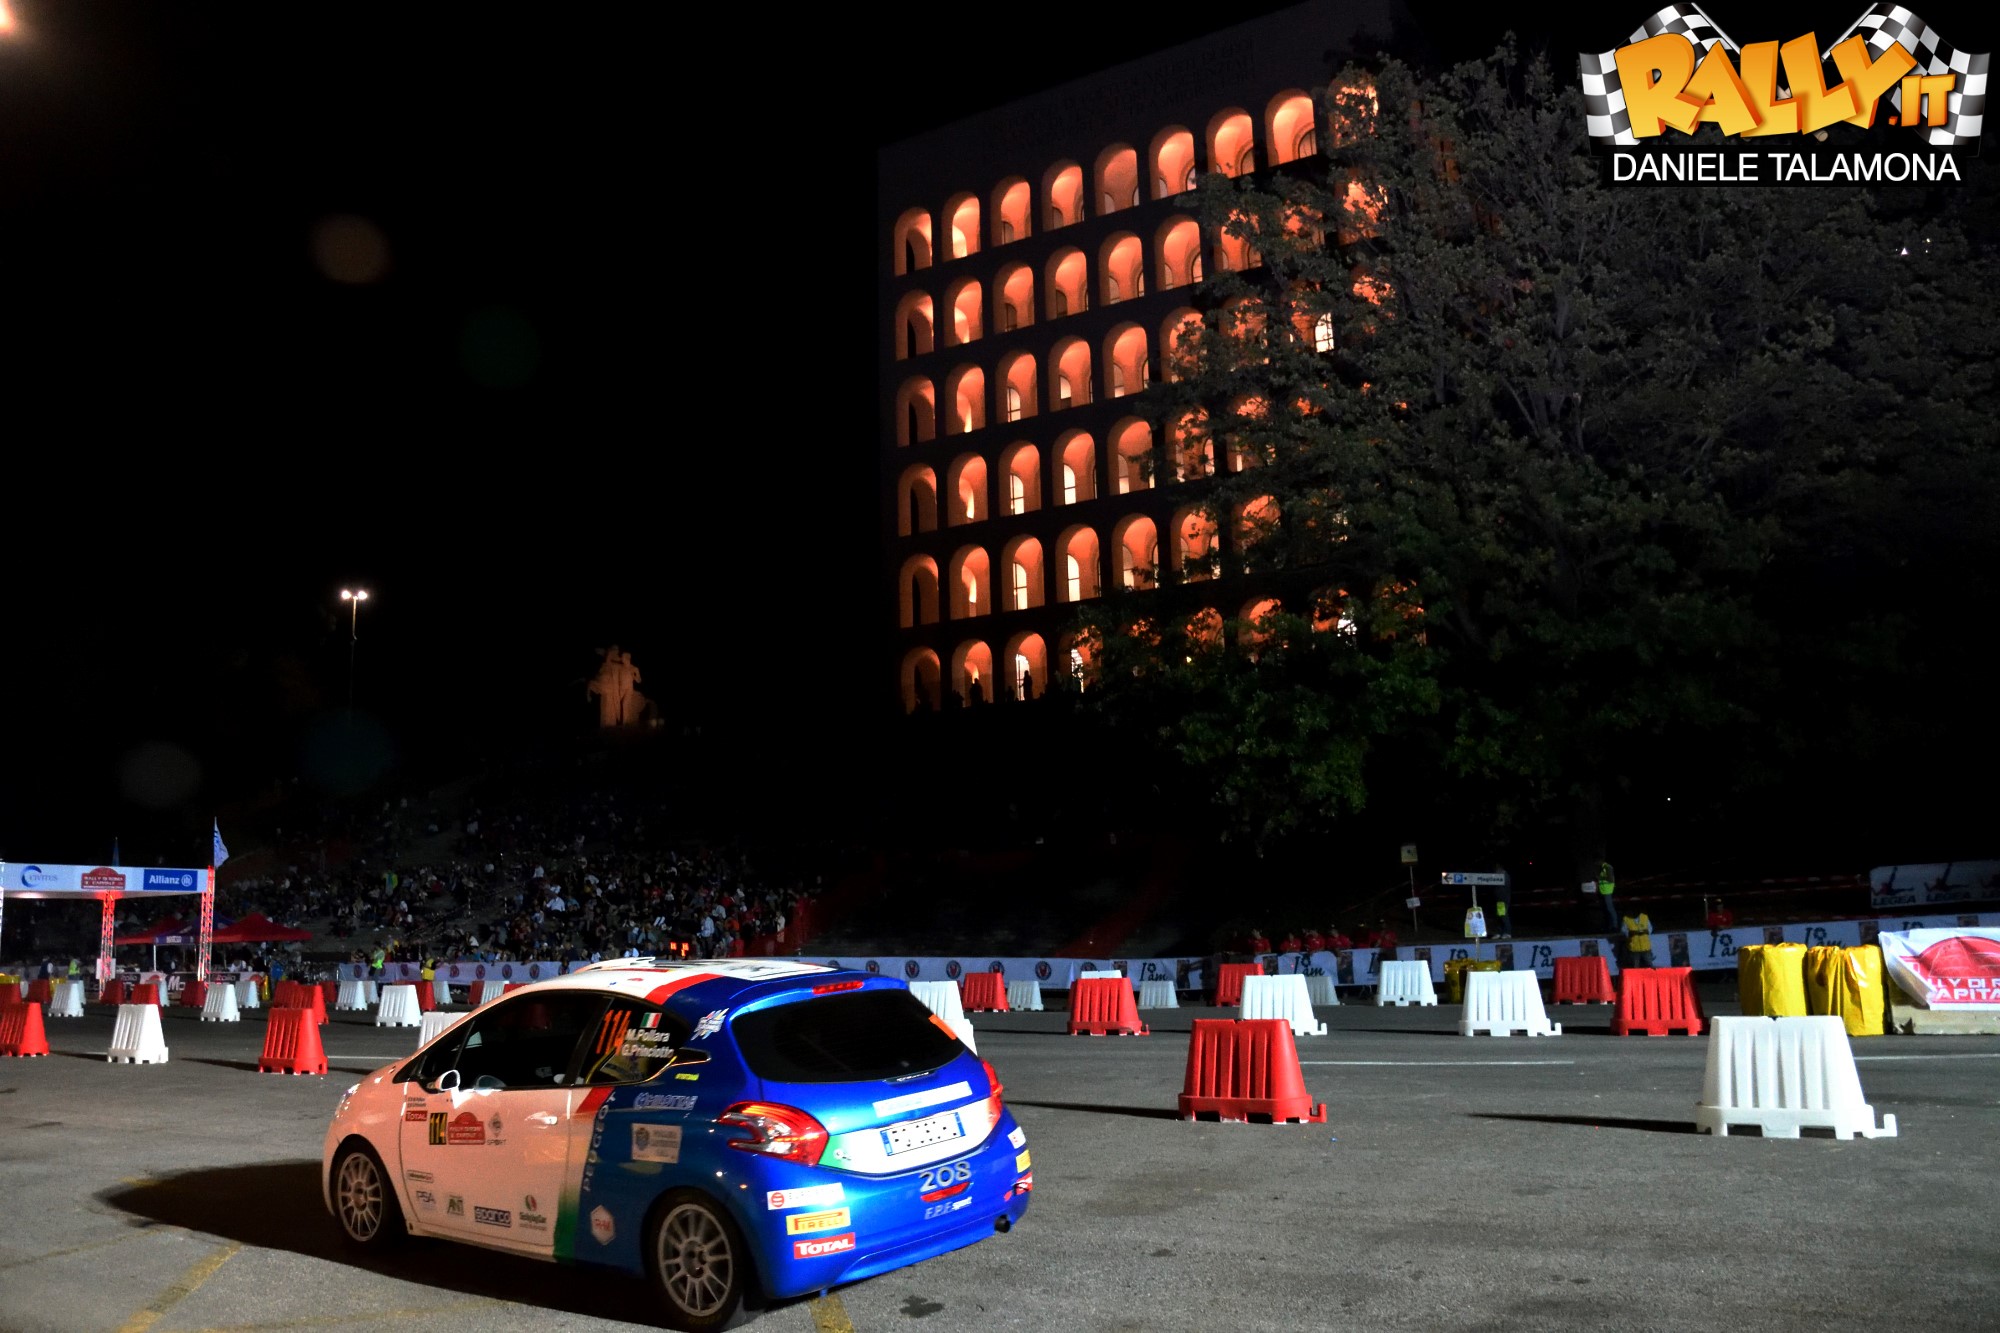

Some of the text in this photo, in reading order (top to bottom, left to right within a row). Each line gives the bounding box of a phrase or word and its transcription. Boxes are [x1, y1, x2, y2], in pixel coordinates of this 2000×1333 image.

[149, 874, 180, 885] Allianz
[1935, 988, 2000, 1001] APITA
[919, 1161, 972, 1193] 208
[474, 1206, 511, 1224] sparco
[794, 1212, 848, 1231] PIRELLI
[795, 1238, 854, 1256] TOTAL
